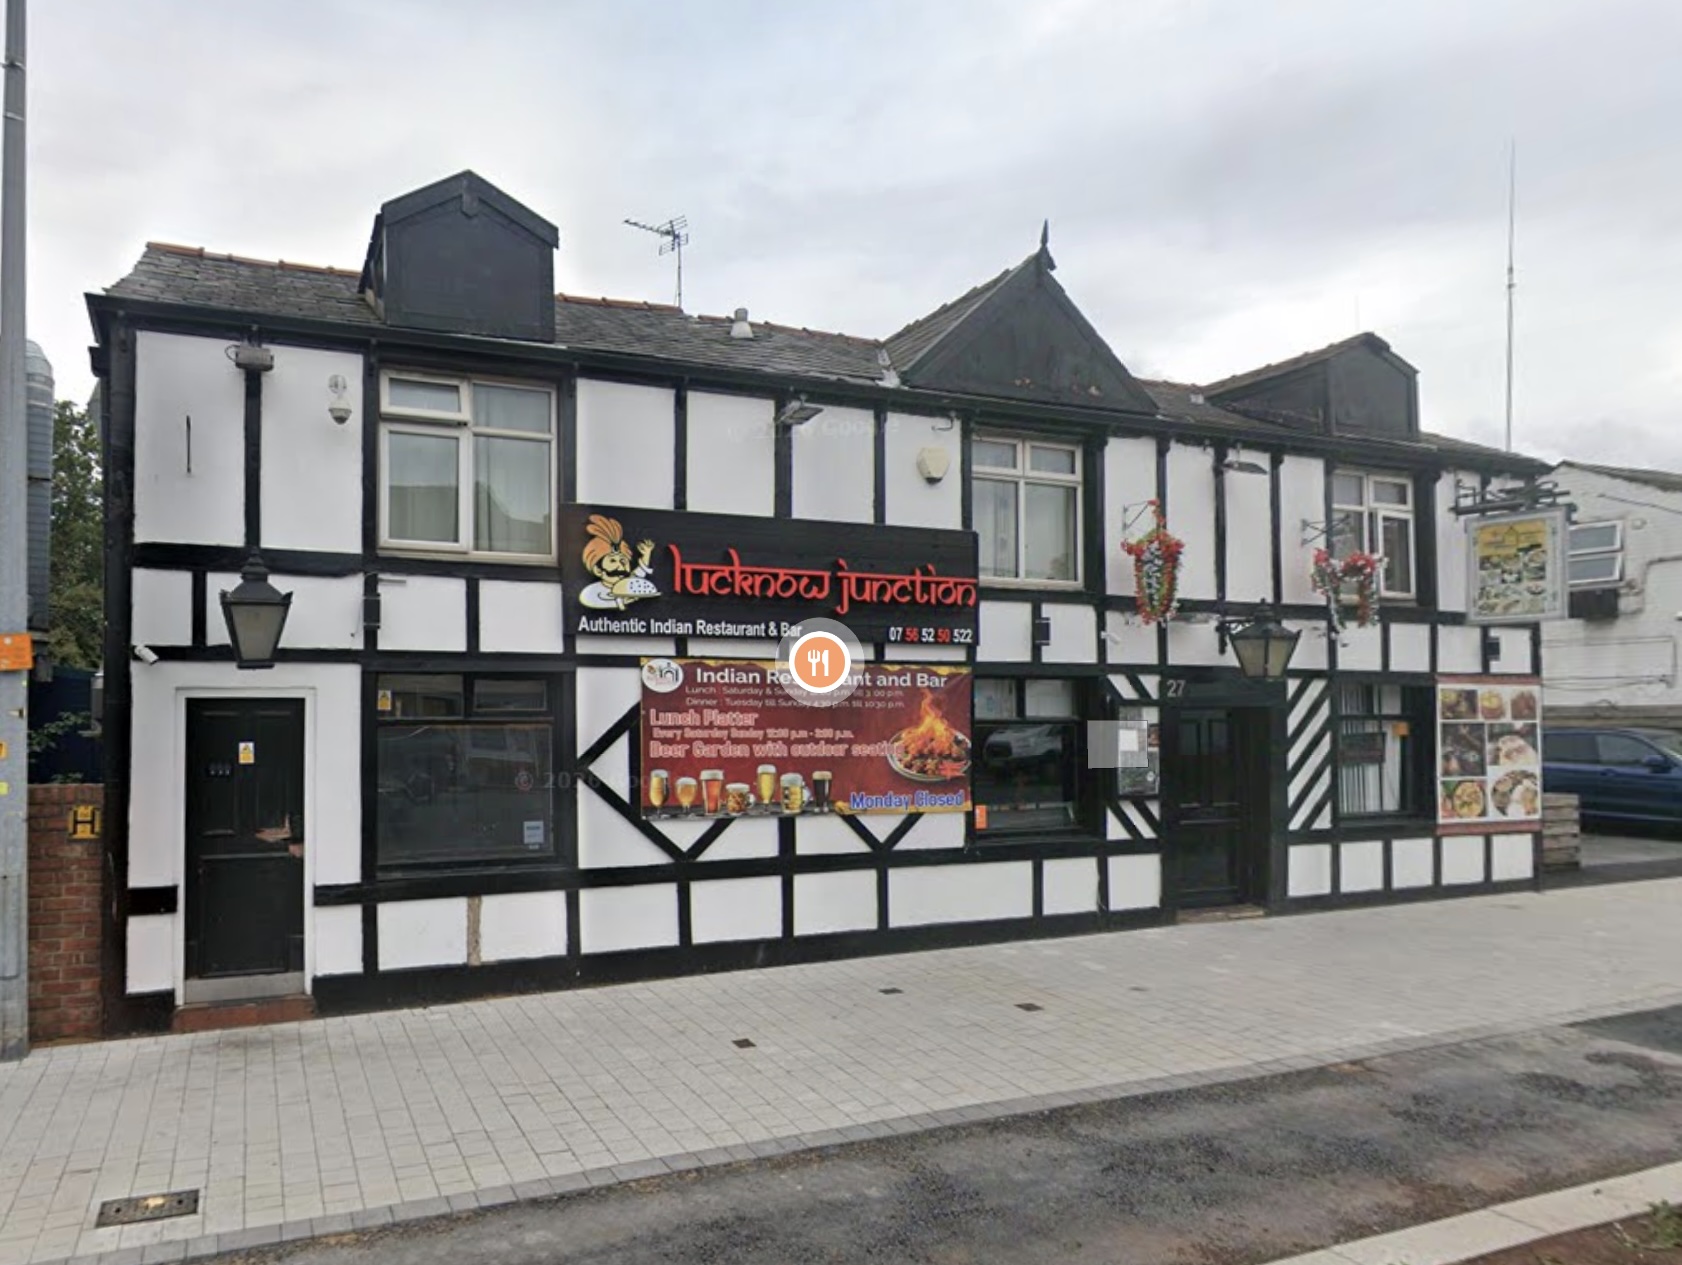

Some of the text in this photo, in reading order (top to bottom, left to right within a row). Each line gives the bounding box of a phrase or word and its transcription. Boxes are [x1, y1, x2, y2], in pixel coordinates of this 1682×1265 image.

[578, 615, 803, 638] Authentic Indian Restaurant & Bar
[888, 626, 904, 642] 07
[921, 627, 935, 643] 52
[952, 628, 973, 644] 522
[696, 668, 948, 688] Indian Reant and Bar
[685, 686, 717, 694] Lunch
[722, 686, 763, 697] Saturday
[1166, 679, 1186, 698] 27
[685, 697, 718, 706] Dinner
[725, 698, 763, 709] Tuesday
[649, 708, 759, 727] Lunch Platter
[649, 740, 690, 758] Beer
[692, 740, 751, 758] Garden
[752, 740, 788, 758] with
[790, 740, 849, 758] outdoor
[850, 789, 967, 811] Monday Closed
